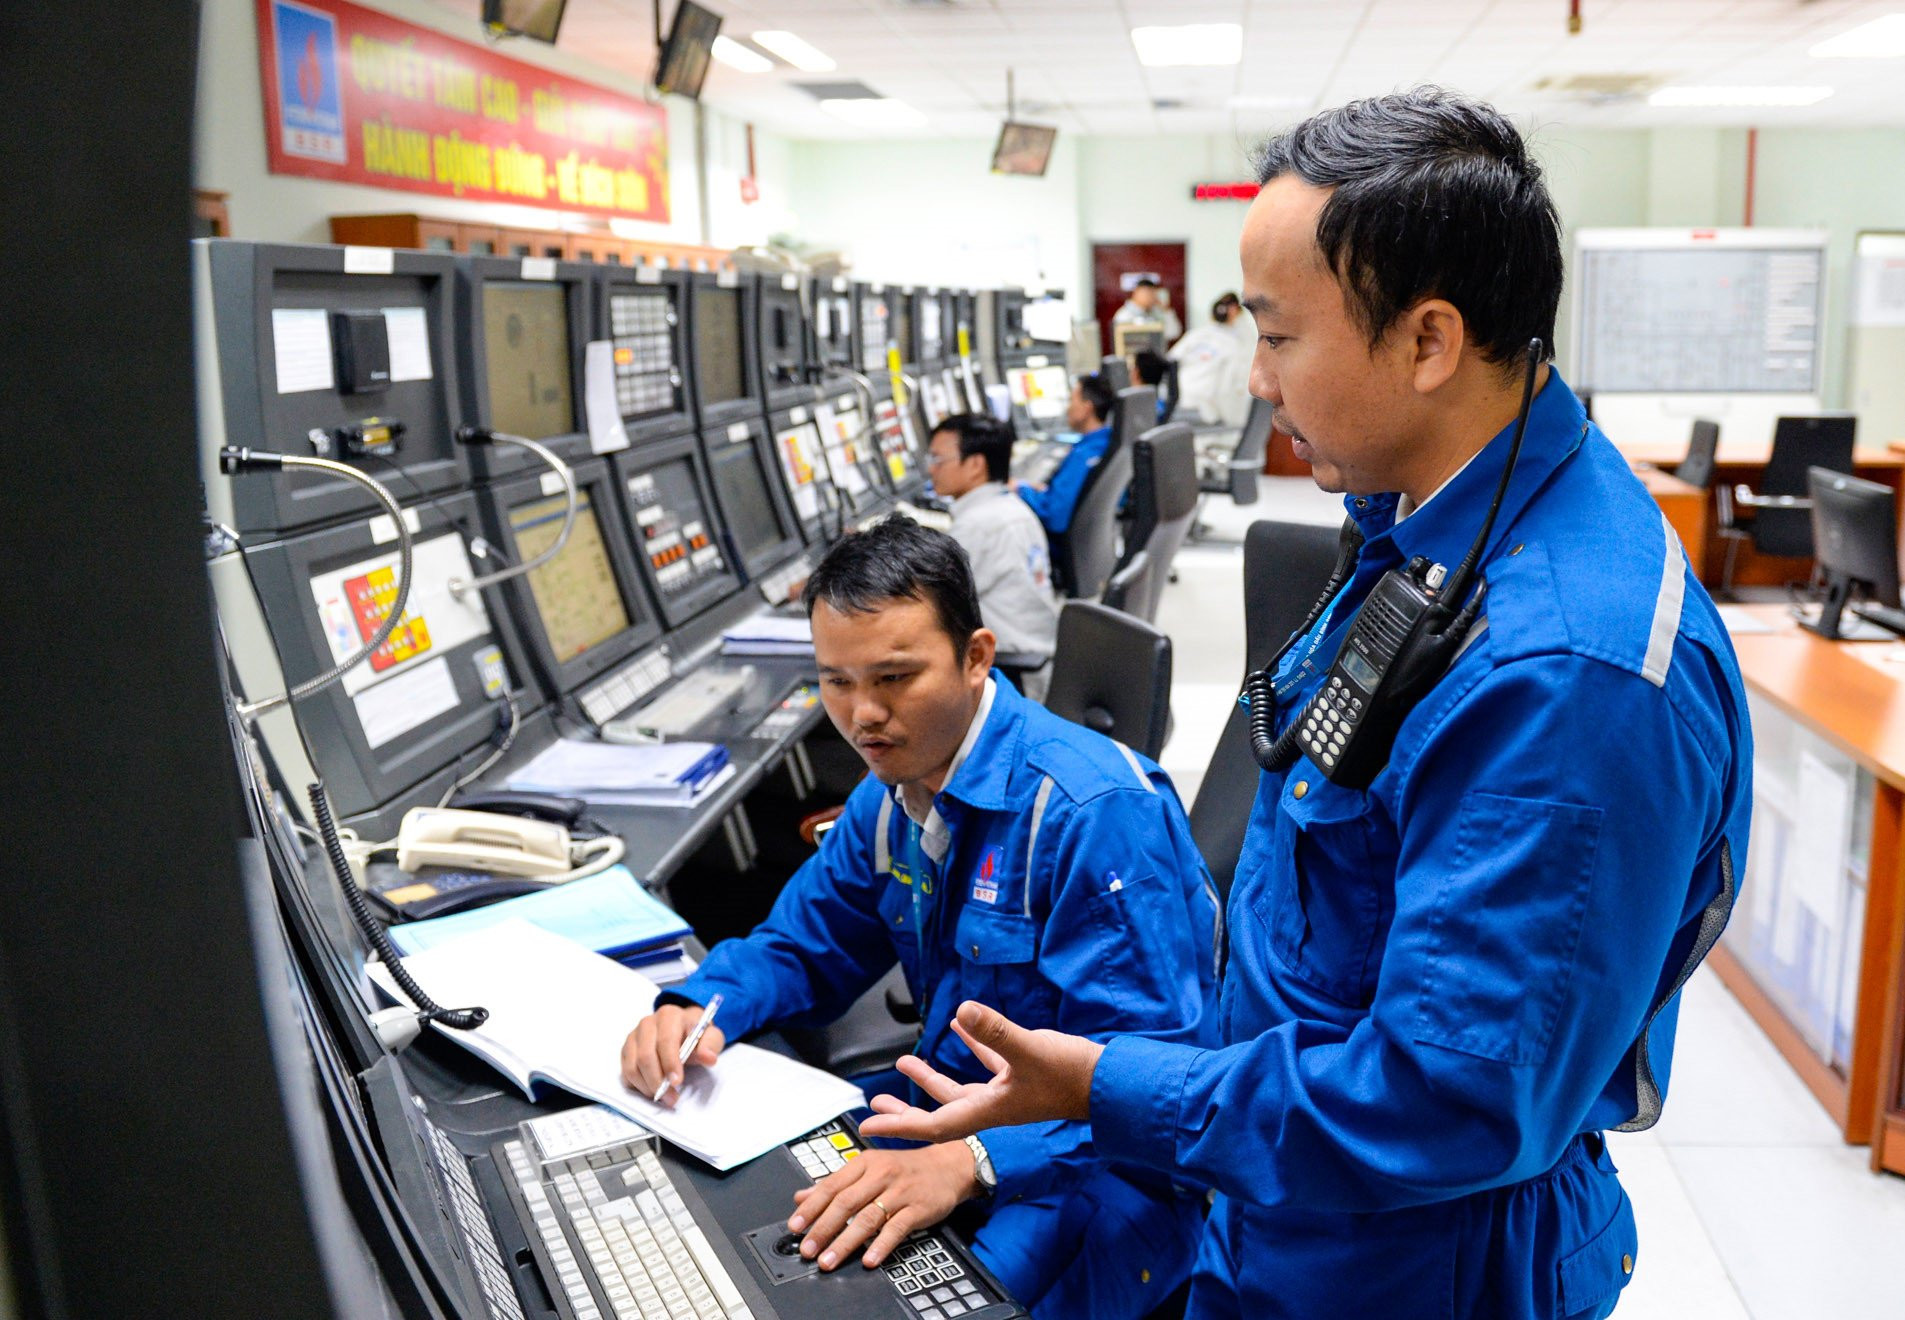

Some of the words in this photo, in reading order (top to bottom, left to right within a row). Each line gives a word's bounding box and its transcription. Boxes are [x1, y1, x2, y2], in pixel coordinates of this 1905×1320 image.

[351, 34, 426, 100] QUYẾT
[481, 73, 519, 124] CAO
[362, 113, 430, 181] HÀNH
[434, 130, 492, 196] ĐỘNG
